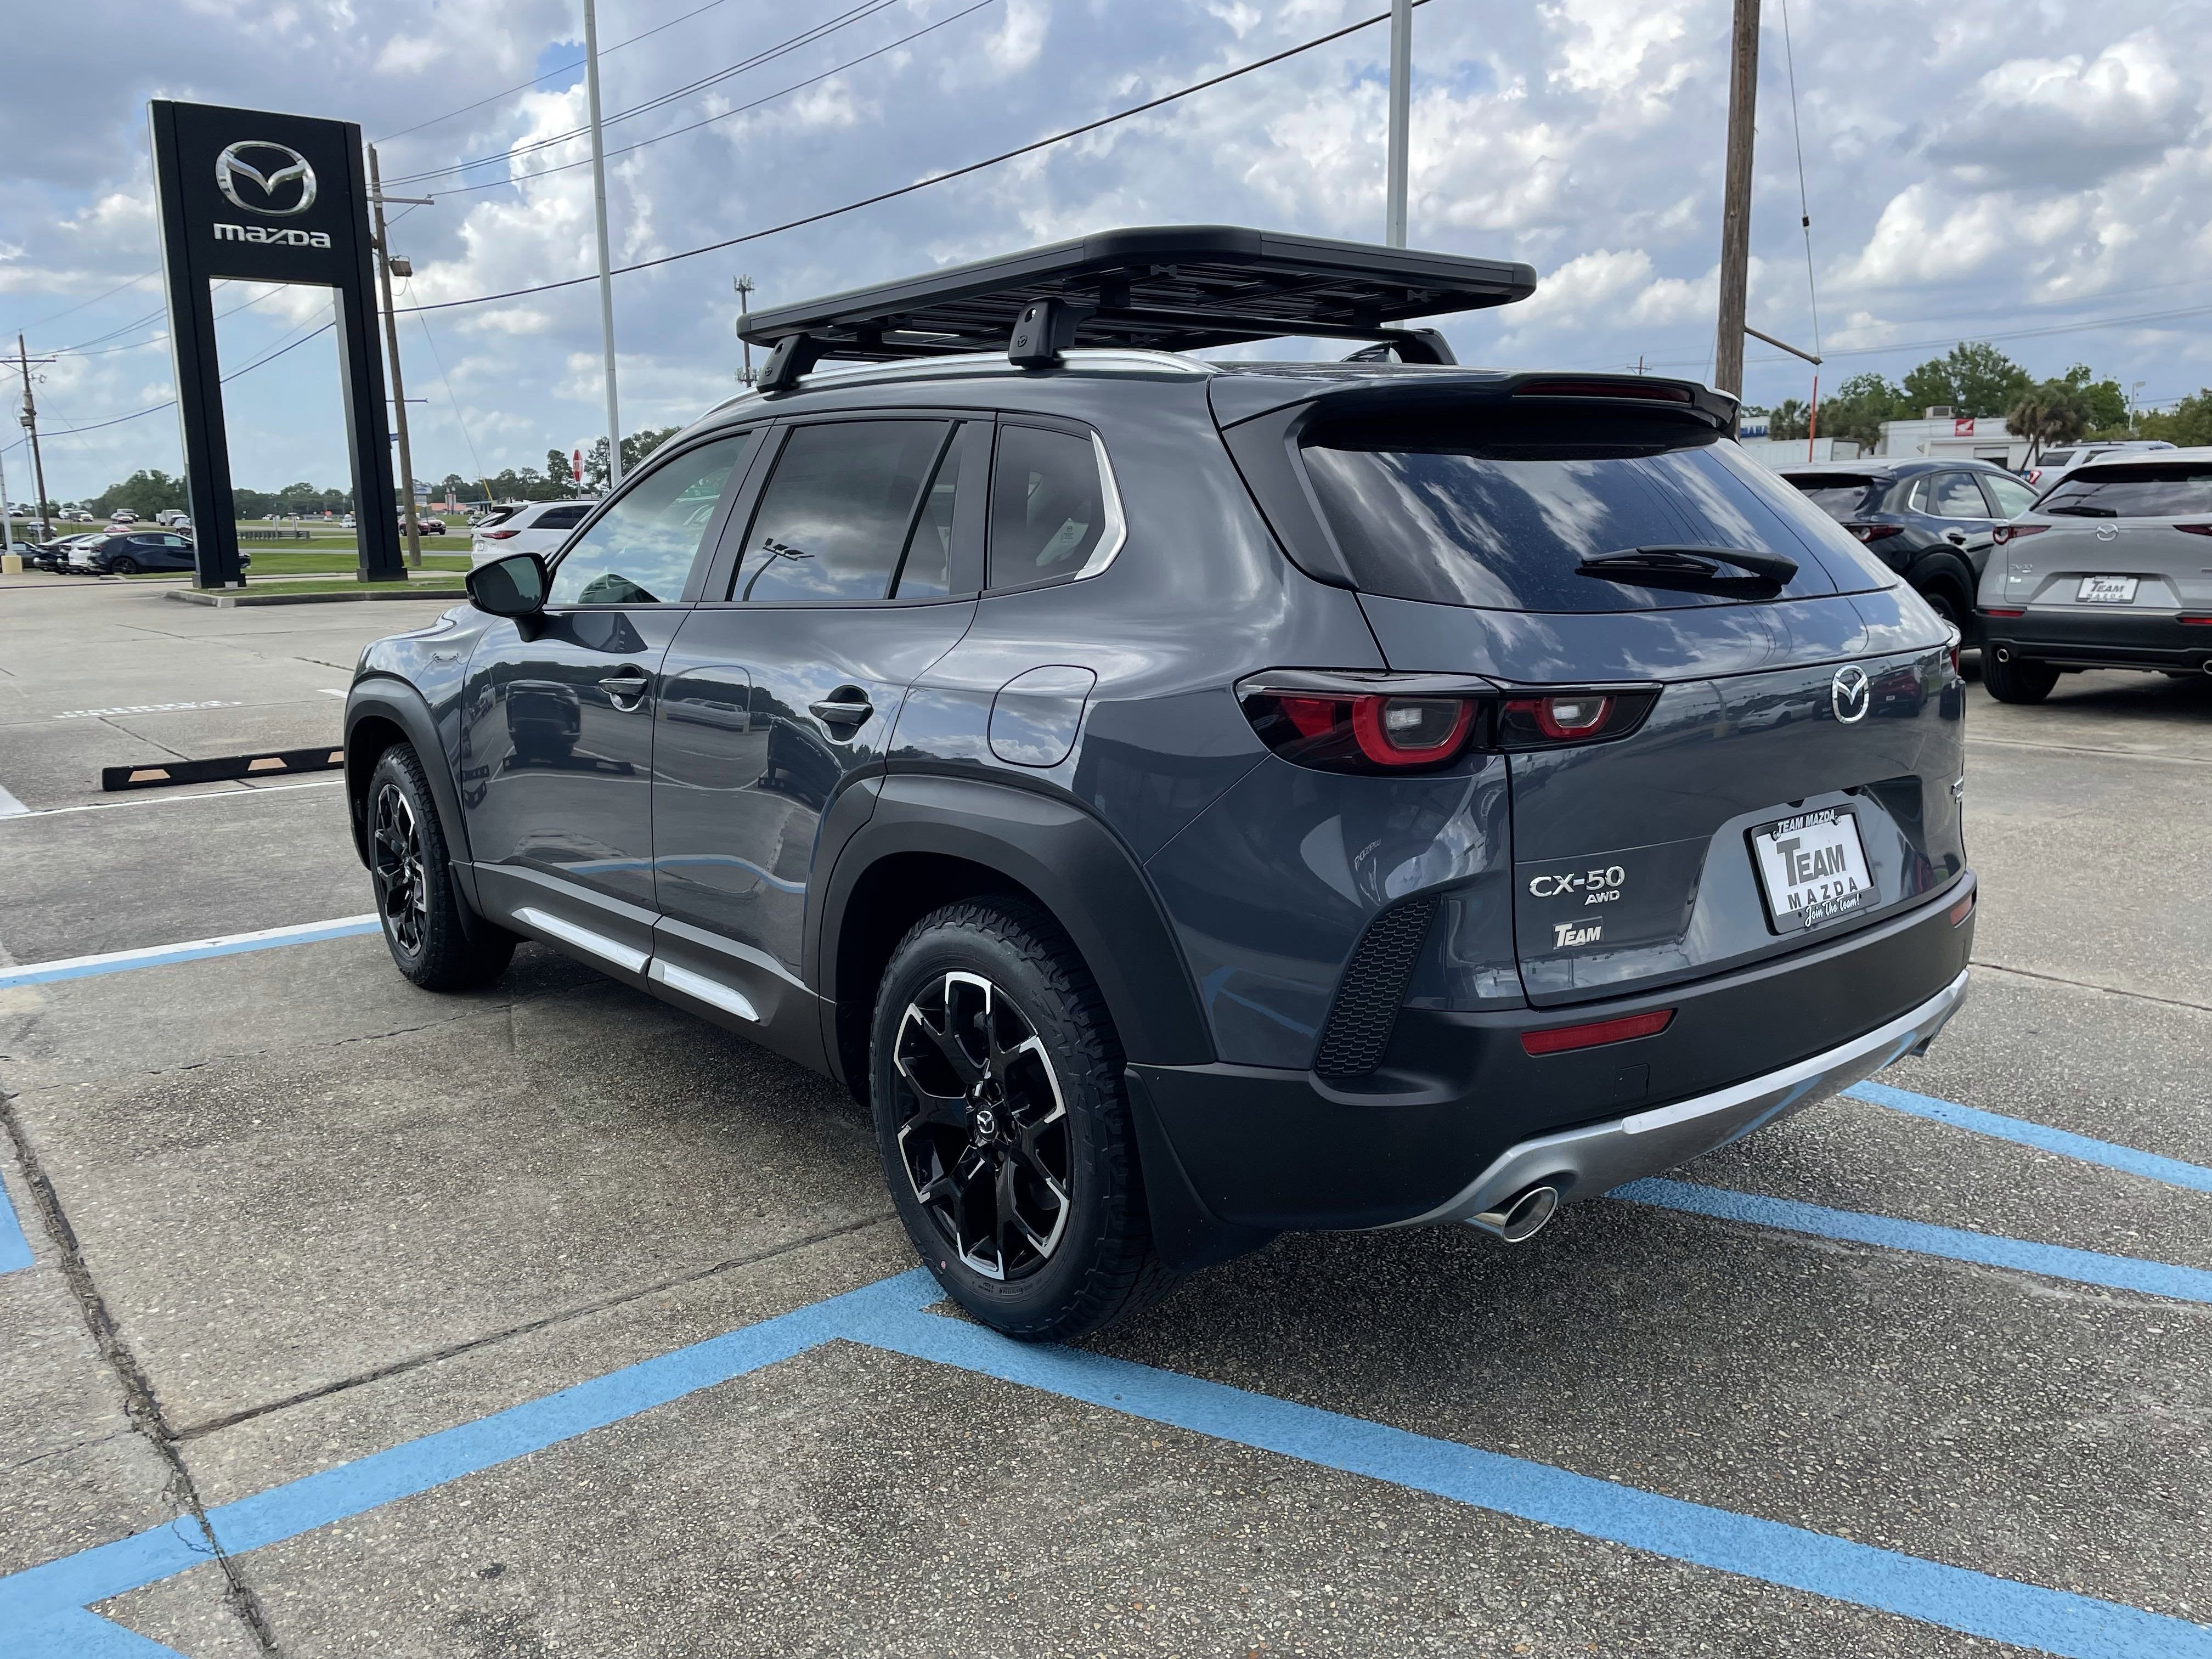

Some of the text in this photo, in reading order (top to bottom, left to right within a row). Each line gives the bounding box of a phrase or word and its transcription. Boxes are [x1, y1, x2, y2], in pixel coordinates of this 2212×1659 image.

[2091, 580, 2125, 592] TEAM
[1778, 809, 1836, 833] TEAM MAZDA
[1776, 837, 1847, 887] TEAM
[1529, 866, 1626, 897] CX-50
[1787, 877, 1858, 910] MAZDA
[1584, 890, 1620, 905] AWD
[1804, 905, 1823, 927] Join
[1821, 900, 1838, 916] The
[1554, 923, 1601, 947] TEAM
